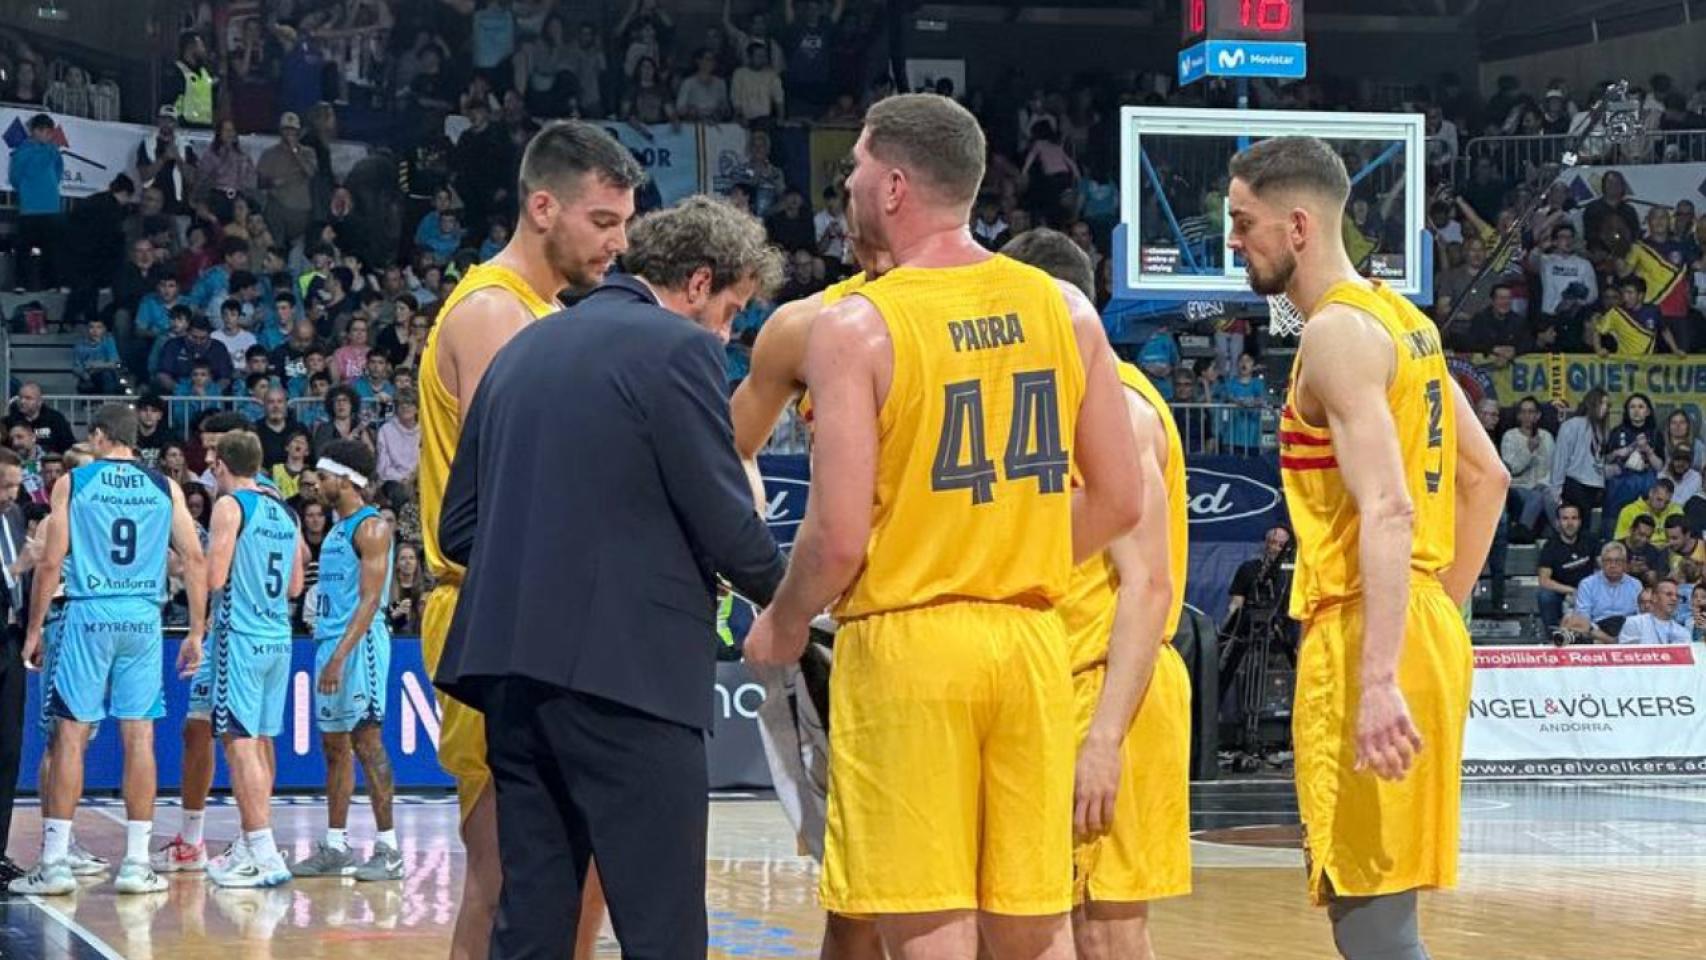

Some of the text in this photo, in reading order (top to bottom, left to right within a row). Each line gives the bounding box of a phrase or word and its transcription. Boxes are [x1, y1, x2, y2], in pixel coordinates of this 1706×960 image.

[1249, 54, 1294, 65] Movistar
[948, 312, 1025, 352] PARRA
[932, 369, 1069, 505] 44
[101, 472, 146, 489] LLOVET
[110, 517, 137, 566] 9
[103, 577, 157, 590] Andorra
[265, 551, 284, 599] 5
[1569, 650, 1607, 663] Real
[1612, 650, 1671, 662] Estate
[1539, 723, 1613, 733] ANDORRA
